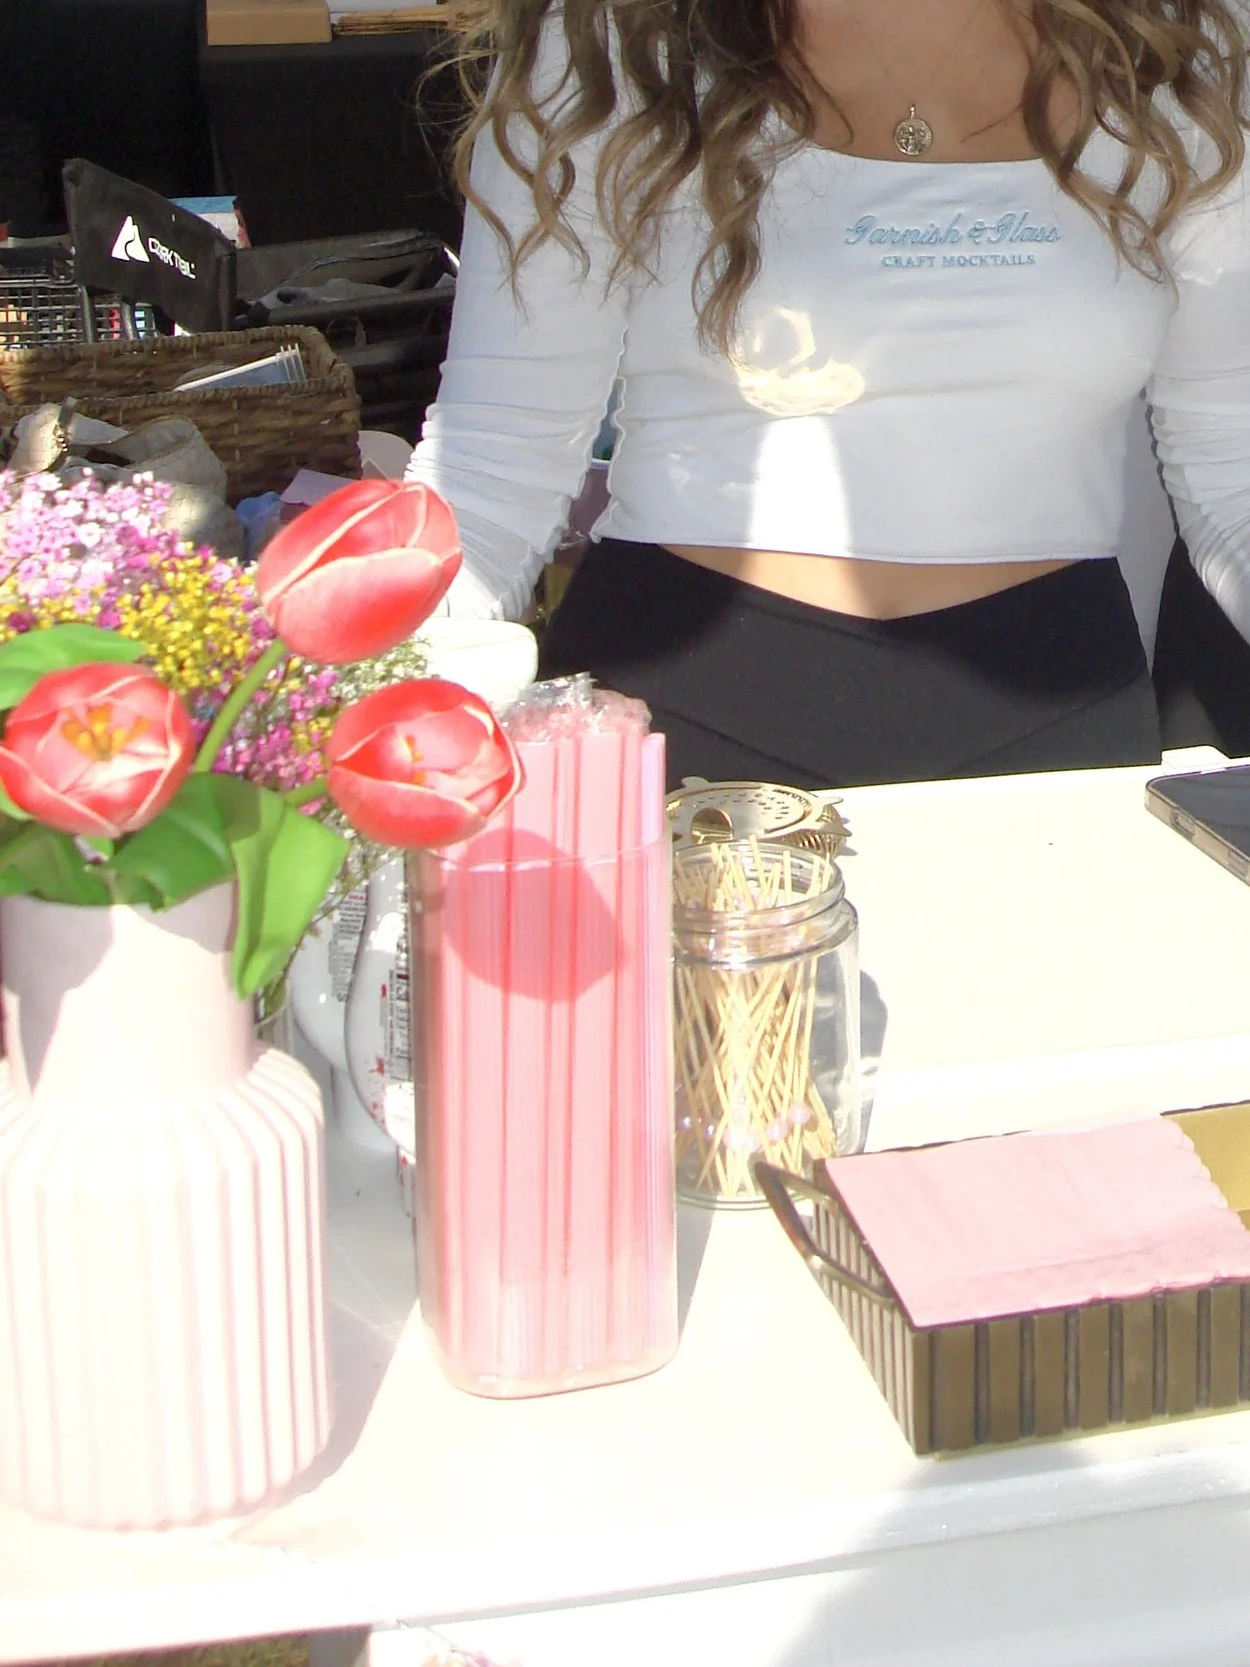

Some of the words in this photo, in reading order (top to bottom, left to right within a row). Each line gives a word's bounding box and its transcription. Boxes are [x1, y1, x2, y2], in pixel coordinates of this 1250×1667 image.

[845, 211, 964, 245] Garnish
[880, 254, 937, 268] CRAFT
[942, 254, 1037, 268] MOCKTAILS
